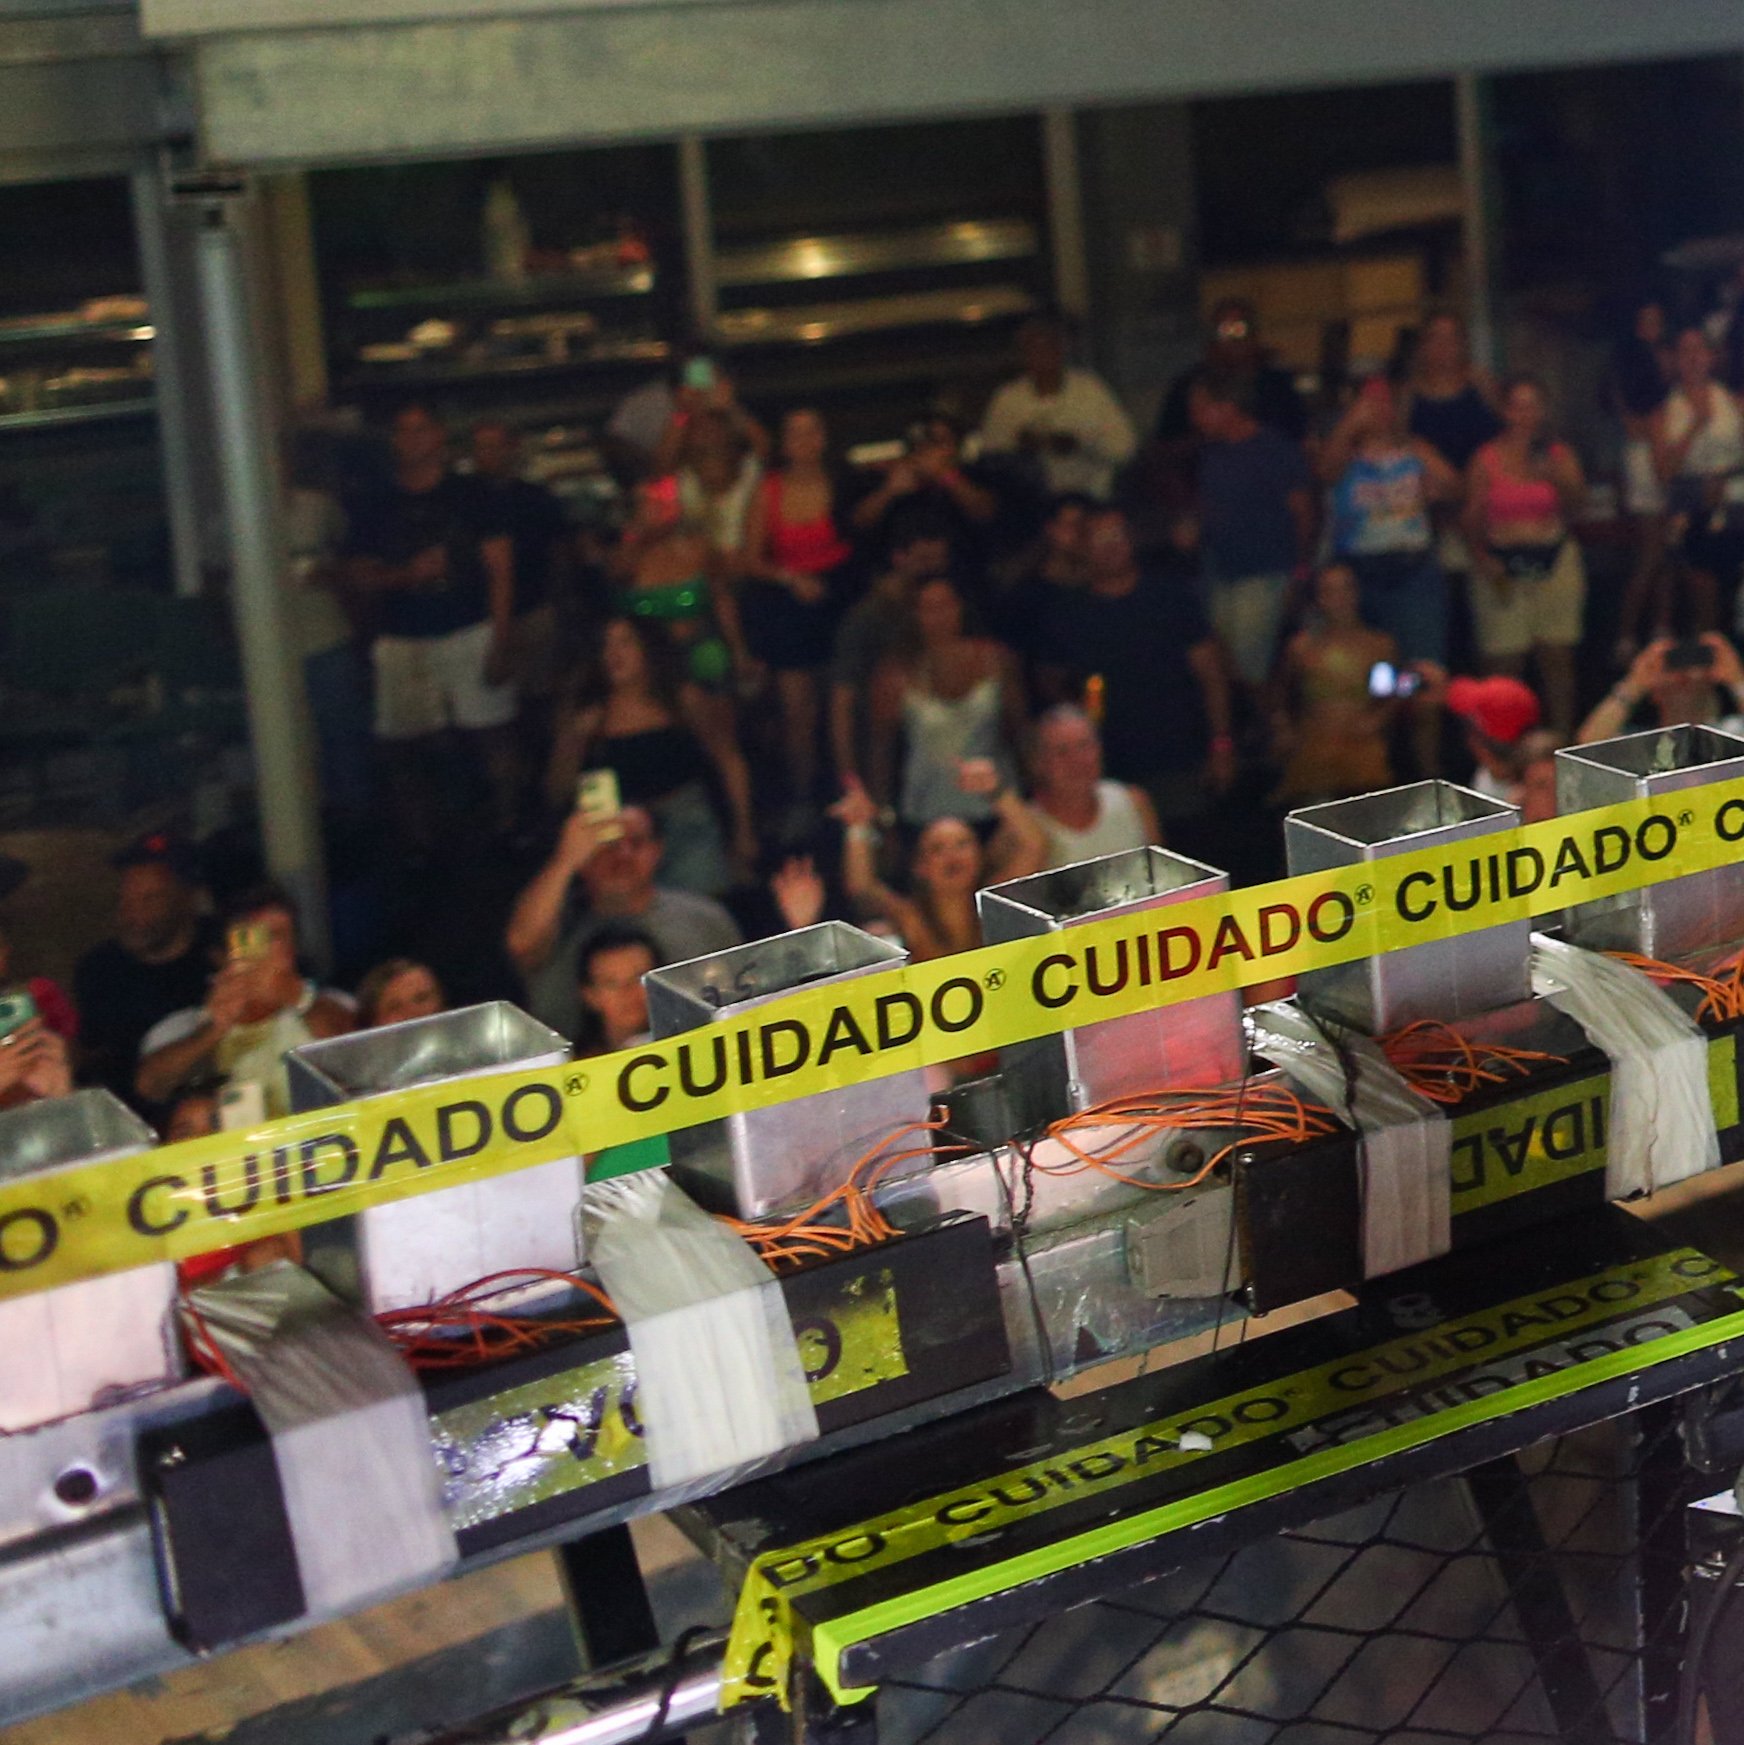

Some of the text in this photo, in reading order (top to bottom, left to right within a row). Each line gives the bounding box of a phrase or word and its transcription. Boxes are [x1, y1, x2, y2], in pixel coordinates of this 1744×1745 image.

[126, 1081, 564, 1237] CUIDADO
[616, 975, 985, 1113] CUIDADO
[1029, 890, 1355, 1009] CUIDADO
[1394, 813, 1680, 923] CUIDADO
